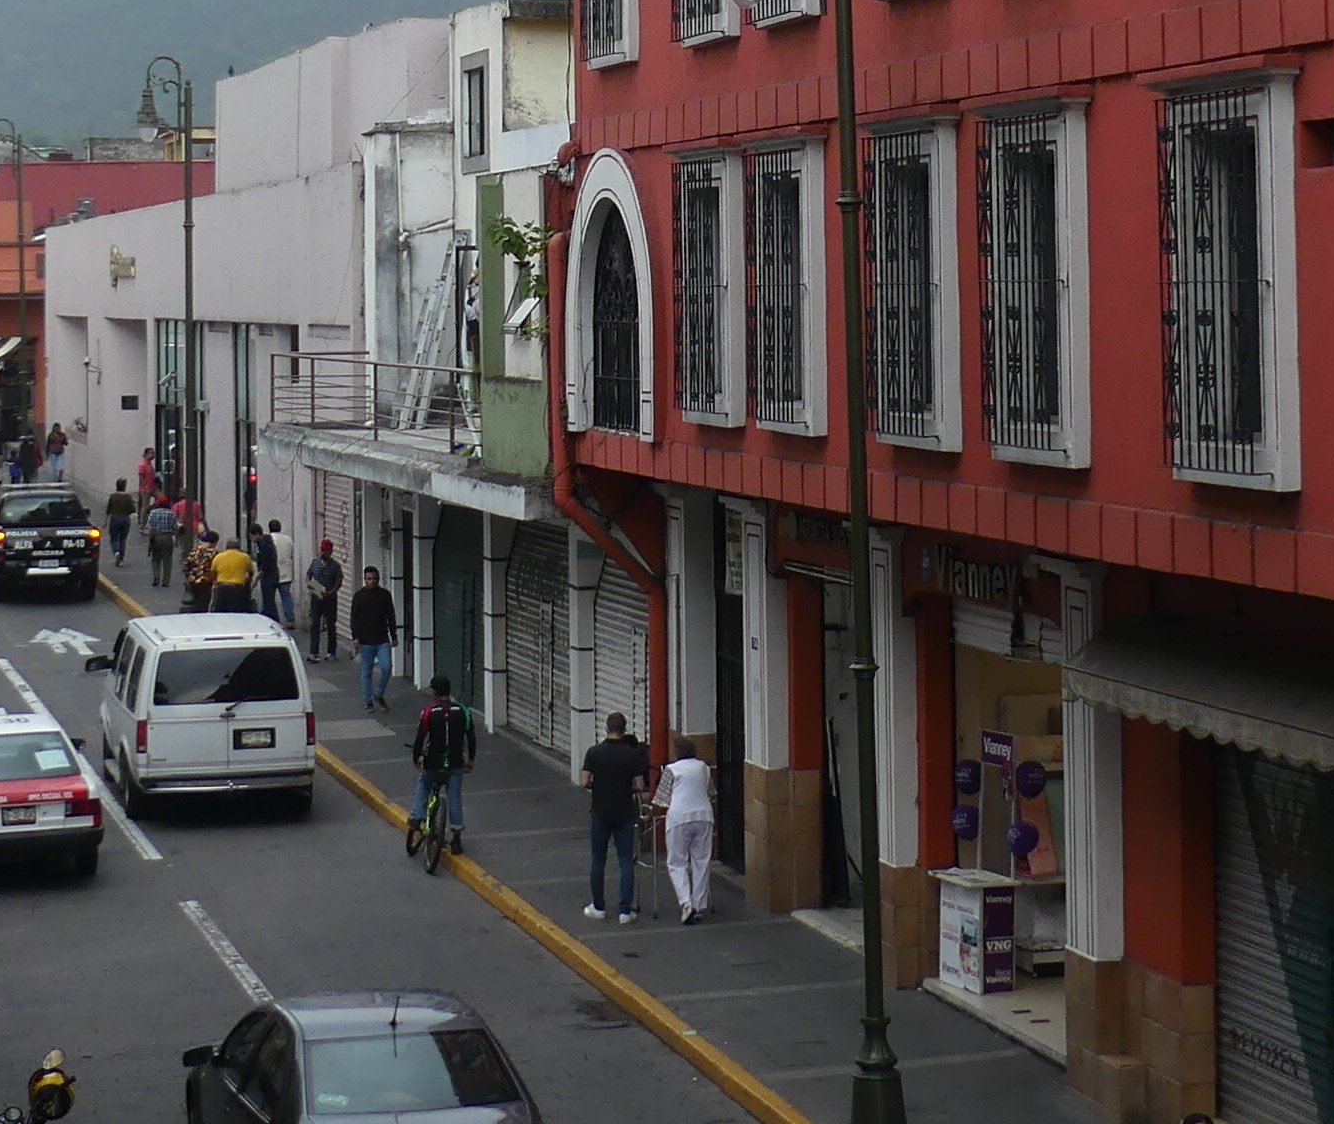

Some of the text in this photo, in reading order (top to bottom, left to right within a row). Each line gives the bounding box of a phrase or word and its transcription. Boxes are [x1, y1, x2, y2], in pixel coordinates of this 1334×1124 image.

[14, 540, 34, 549] ALFA
[934, 544, 1020, 607] Vianney
[983, 737, 1012, 761] Vianney
[986, 939, 1013, 953] VNG
